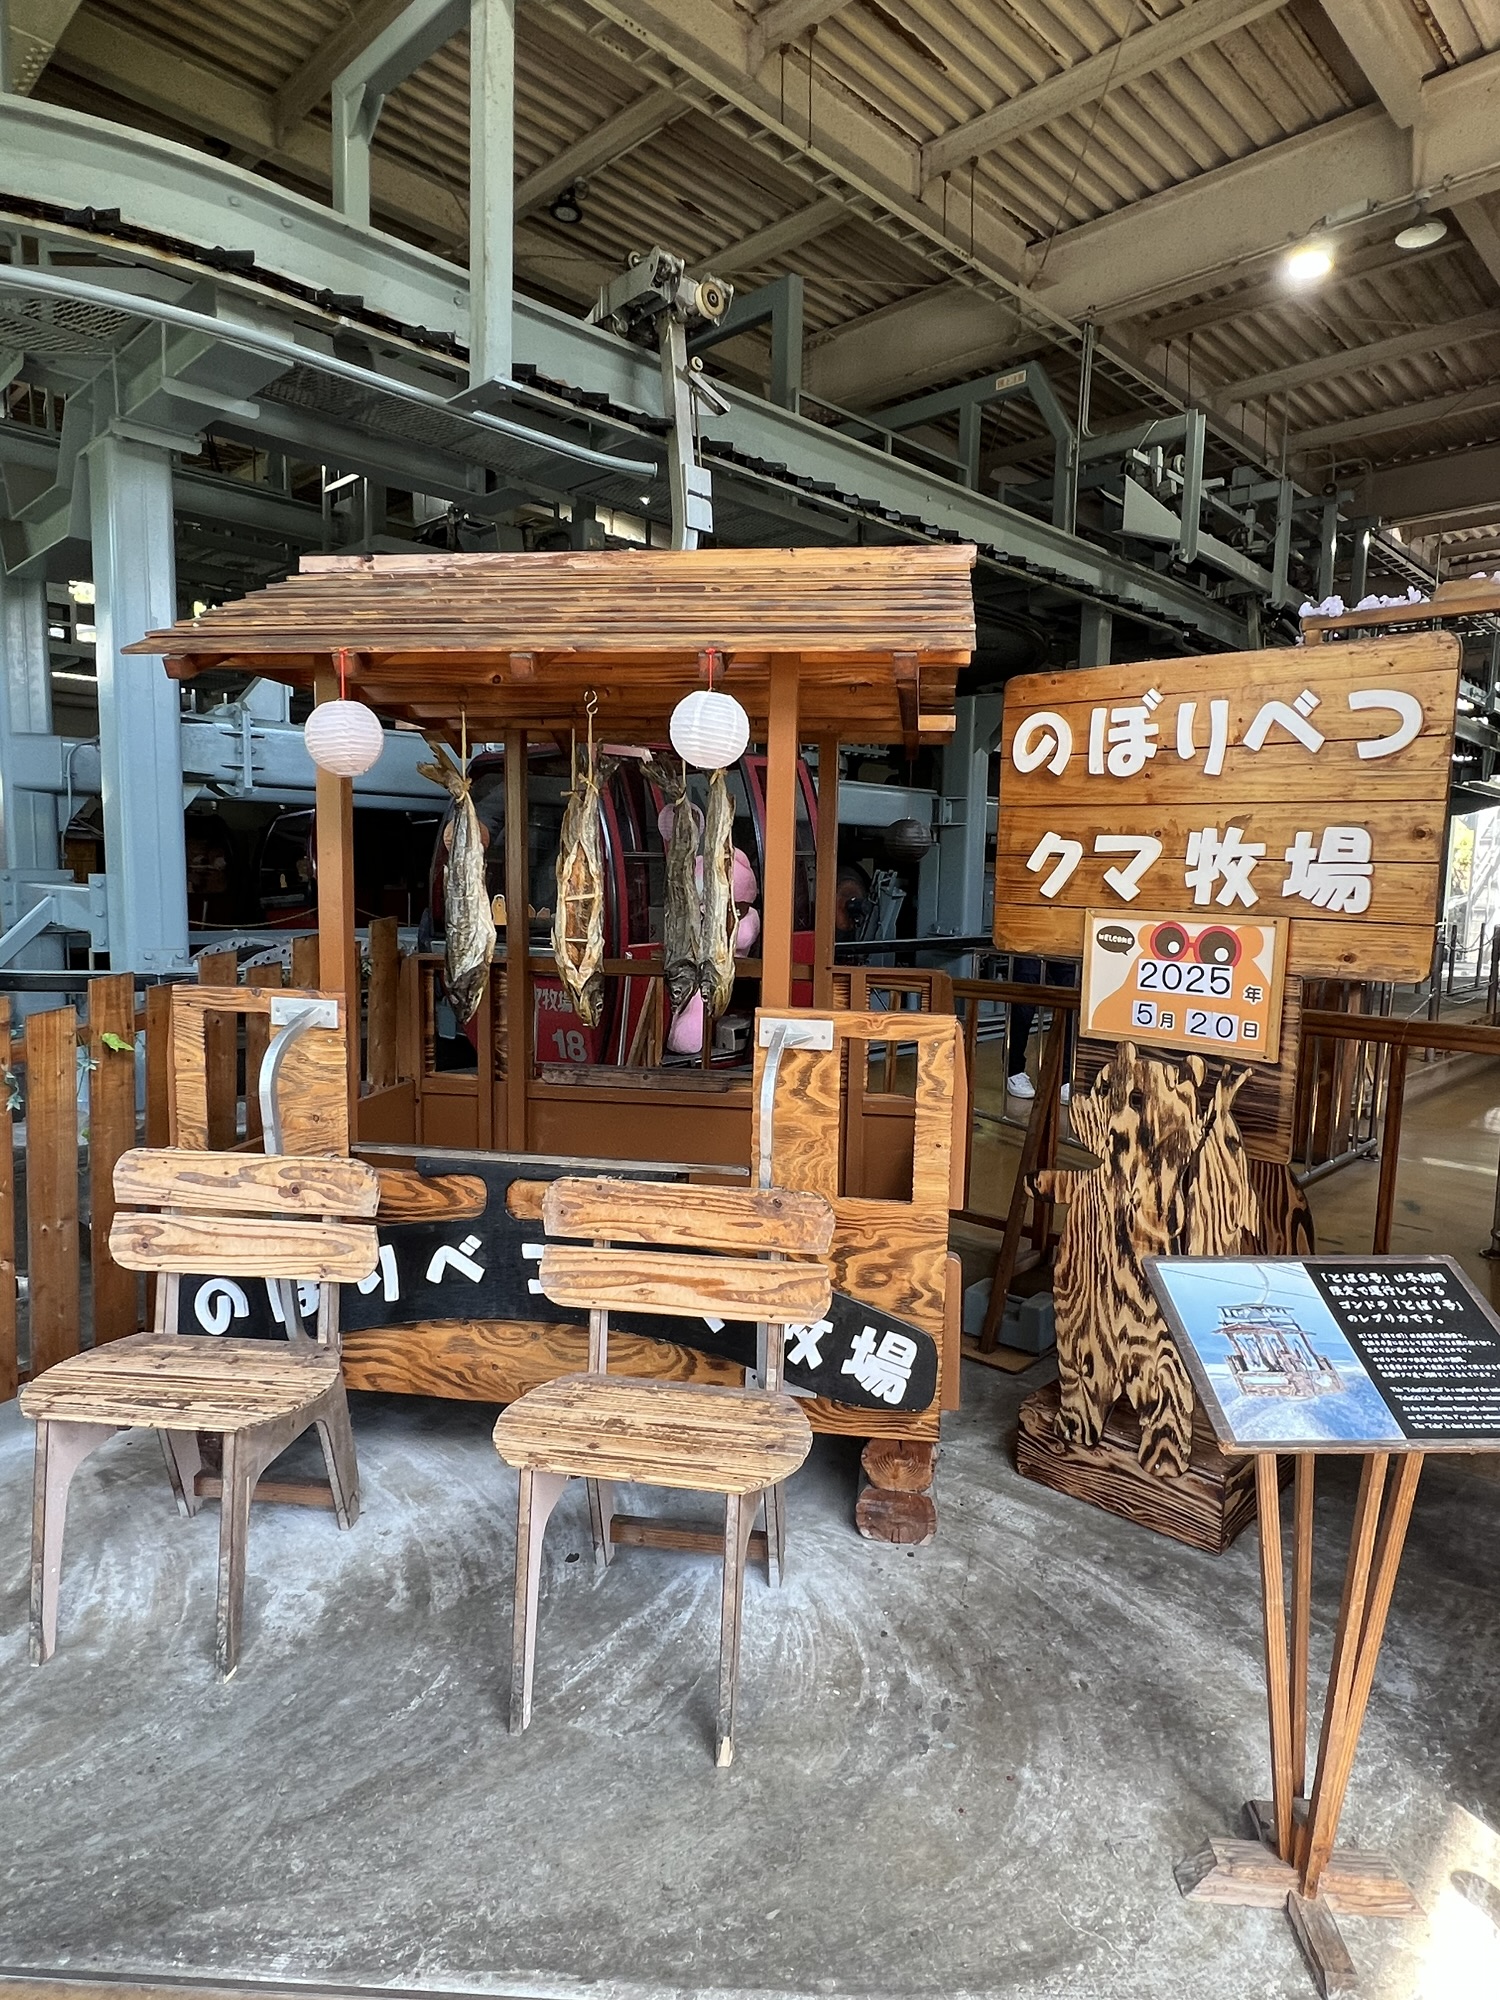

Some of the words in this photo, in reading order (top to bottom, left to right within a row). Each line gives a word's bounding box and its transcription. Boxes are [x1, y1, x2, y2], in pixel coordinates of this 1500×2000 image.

[1012, 688, 1424, 777] のぼりべつ
[1026, 826, 1375, 914] クマ牧場
[1098, 933, 1133, 945] WELCOME
[552, 1028, 588, 1062] 18
